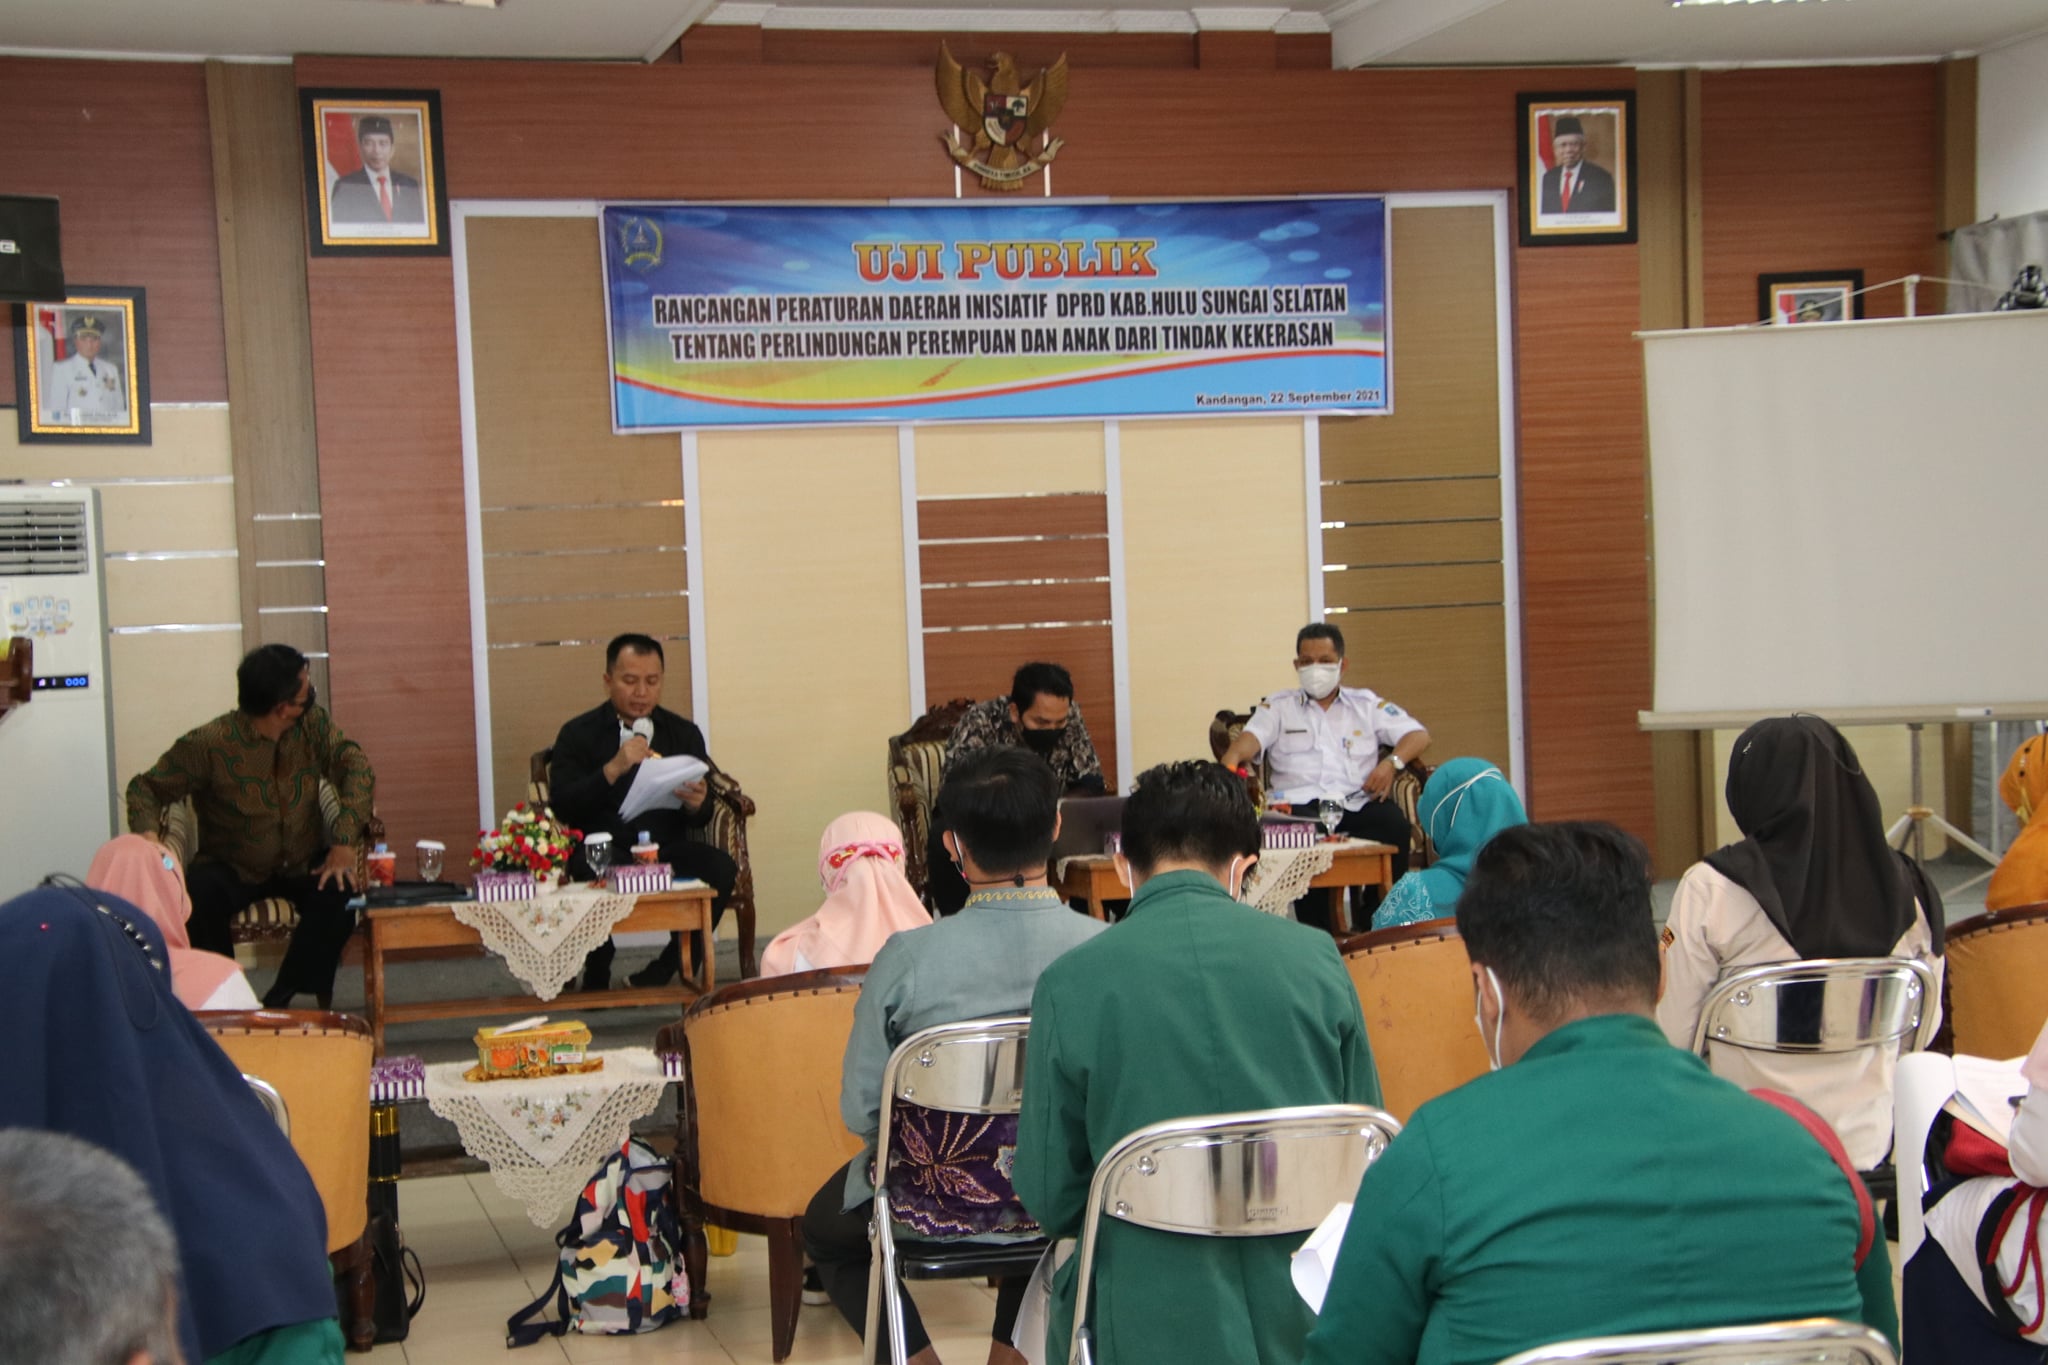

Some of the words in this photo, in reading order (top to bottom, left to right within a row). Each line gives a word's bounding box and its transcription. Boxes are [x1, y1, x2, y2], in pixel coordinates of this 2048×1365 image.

[854, 243, 944, 281] UJI
[956, 241, 1157, 280] PUBLIK
[654, 297, 771, 324] RANCANGAN
[776, 295, 884, 322] PERATURAN
[889, 295, 961, 321] DAERAH
[966, 293, 1048, 319] INISIATIF
[1056, 292, 1106, 318] DPRD
[1202, 289, 1268, 315] SUNGAI
[1273, 287, 1346, 314] SELATAN
[671, 333, 756, 360] TENTANG
[761, 331, 902, 358] PERLINDUNGAN
[907, 329, 1016, 356] PEREMPUAN
[1021, 328, 1057, 353] DAN
[1062, 327, 1110, 352] ANAK
[1115, 326, 1157, 351] DARI
[1162, 325, 1227, 350] TINDAK
[1232, 322, 1333, 349] KEKERASAN
[1196, 394, 1267, 407] Kandangan,
[1270, 393, 1284, 404] 22
[1288, 392, 1352, 405] September
[1356, 390, 1380, 401] 2021
